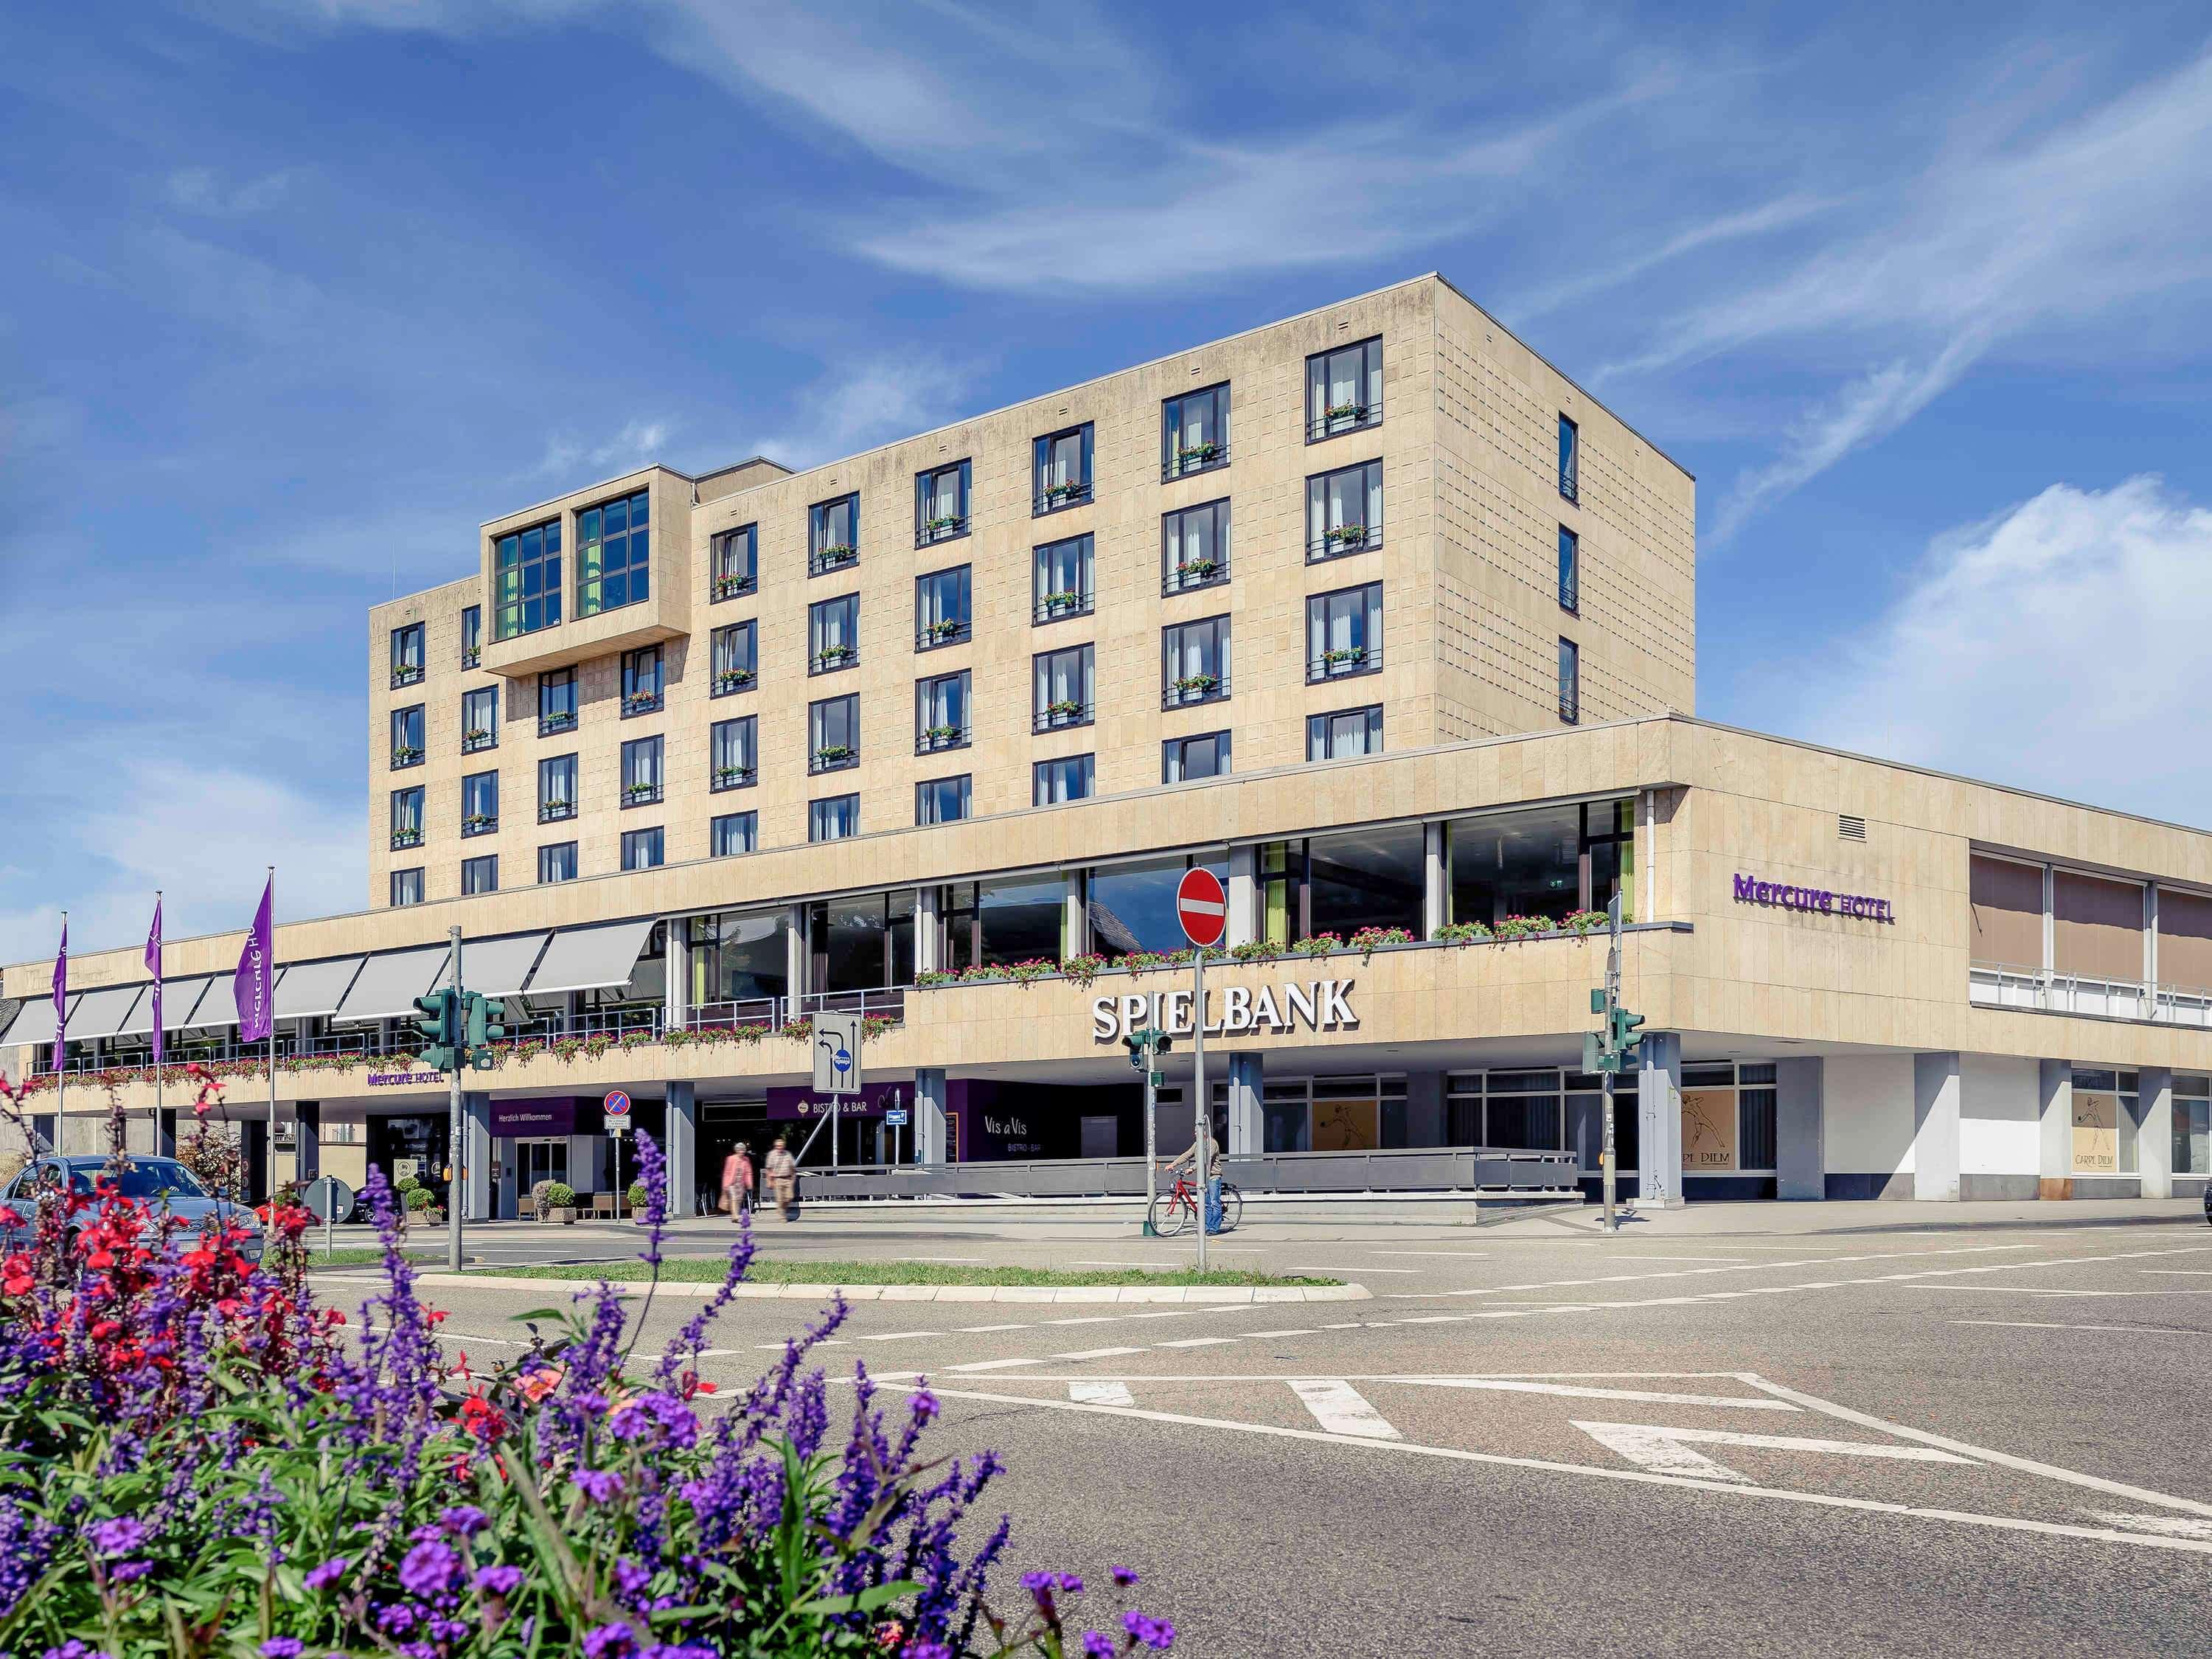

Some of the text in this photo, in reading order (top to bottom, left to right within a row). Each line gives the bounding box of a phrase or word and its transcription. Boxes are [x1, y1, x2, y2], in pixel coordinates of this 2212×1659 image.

[1733, 873, 1894, 921] Mercure HOTEL
[1092, 978, 1359, 1039] SPIELBANK
[368, 1071, 444, 1085] Mercure HOTEL
[843, 1102, 849, 1112] &
[852, 1102, 867, 1112] BAR
[498, 1113, 552, 1122] Herzlich Willkommen
[985, 1116, 1001, 1134] Vis
[1012, 1117, 1027, 1135] Vis
